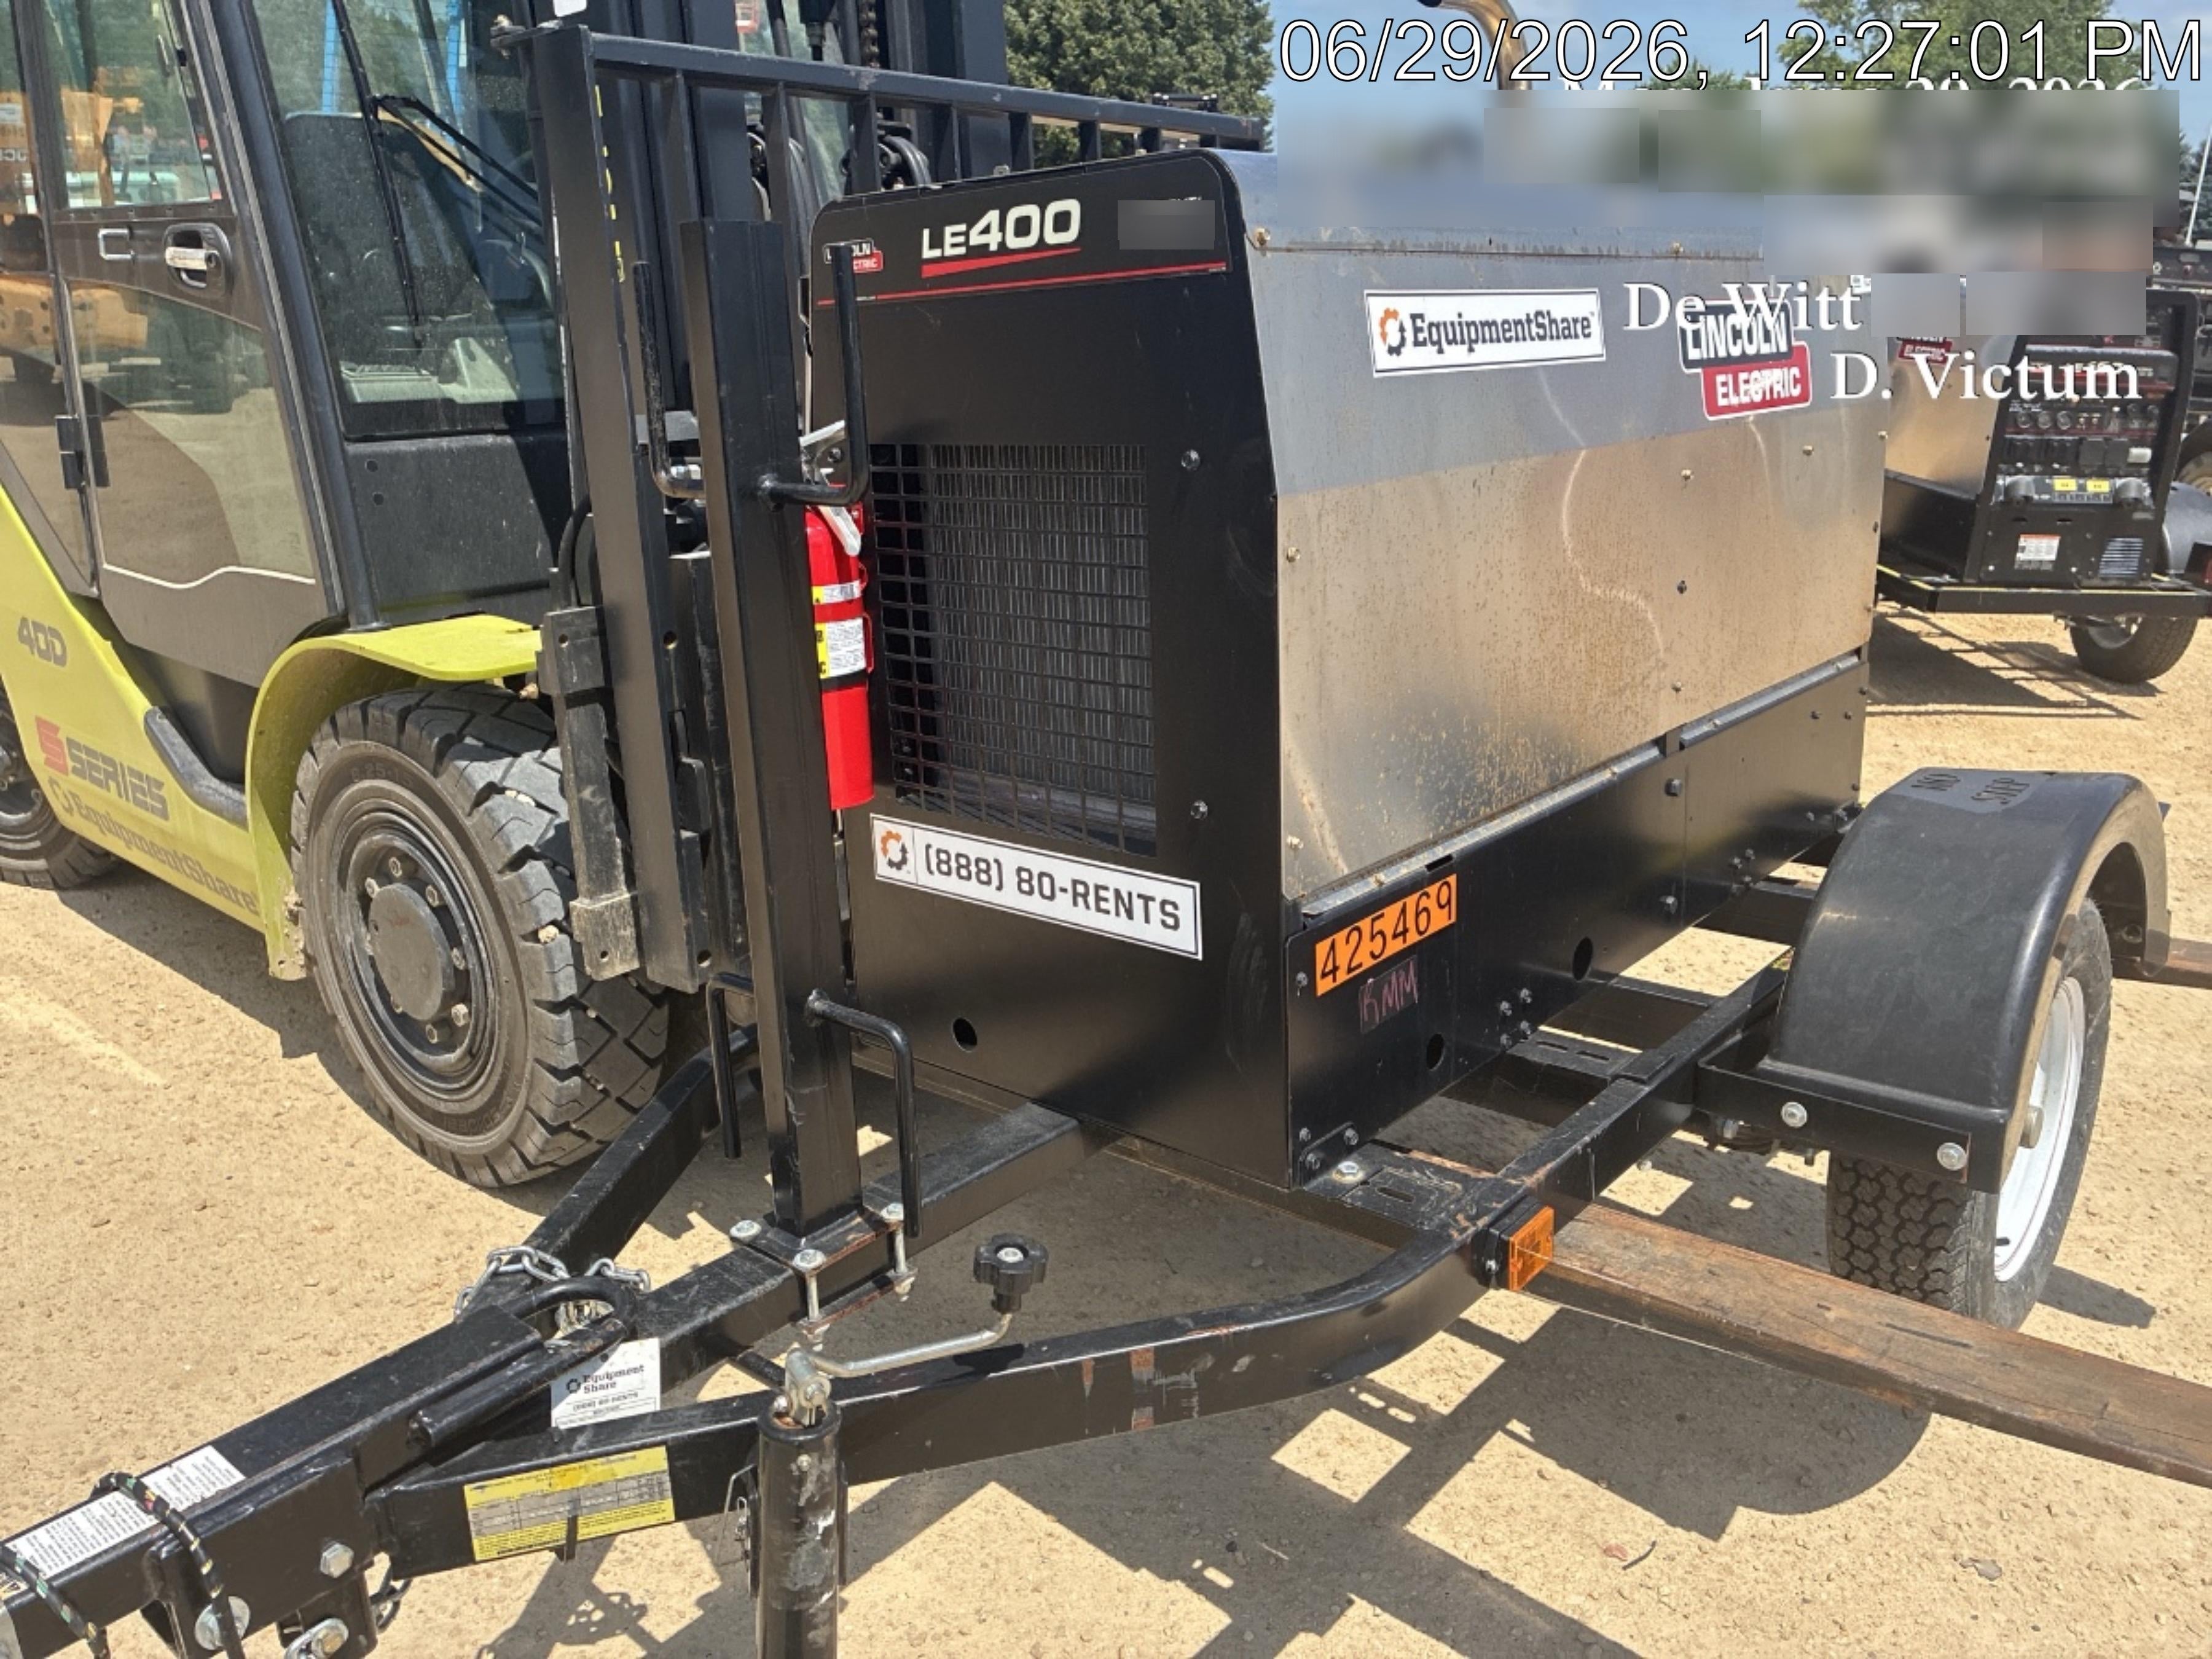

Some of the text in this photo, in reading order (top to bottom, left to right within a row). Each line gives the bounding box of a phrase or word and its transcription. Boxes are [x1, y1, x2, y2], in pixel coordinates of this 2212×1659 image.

[922, 198, 1080, 259] LE400
[1410, 310, 1593, 355] EquipmentShare
[1685, 307, 1789, 361] LINCOLN
[1716, 366, 1802, 407] ELECTRIC
[65, 736, 170, 822] SERIES
[66, 790, 261, 917] EquipmentShare
[925, 843, 1181, 932] (888) 80-RENTS
[1319, 880, 1453, 984] 425469
